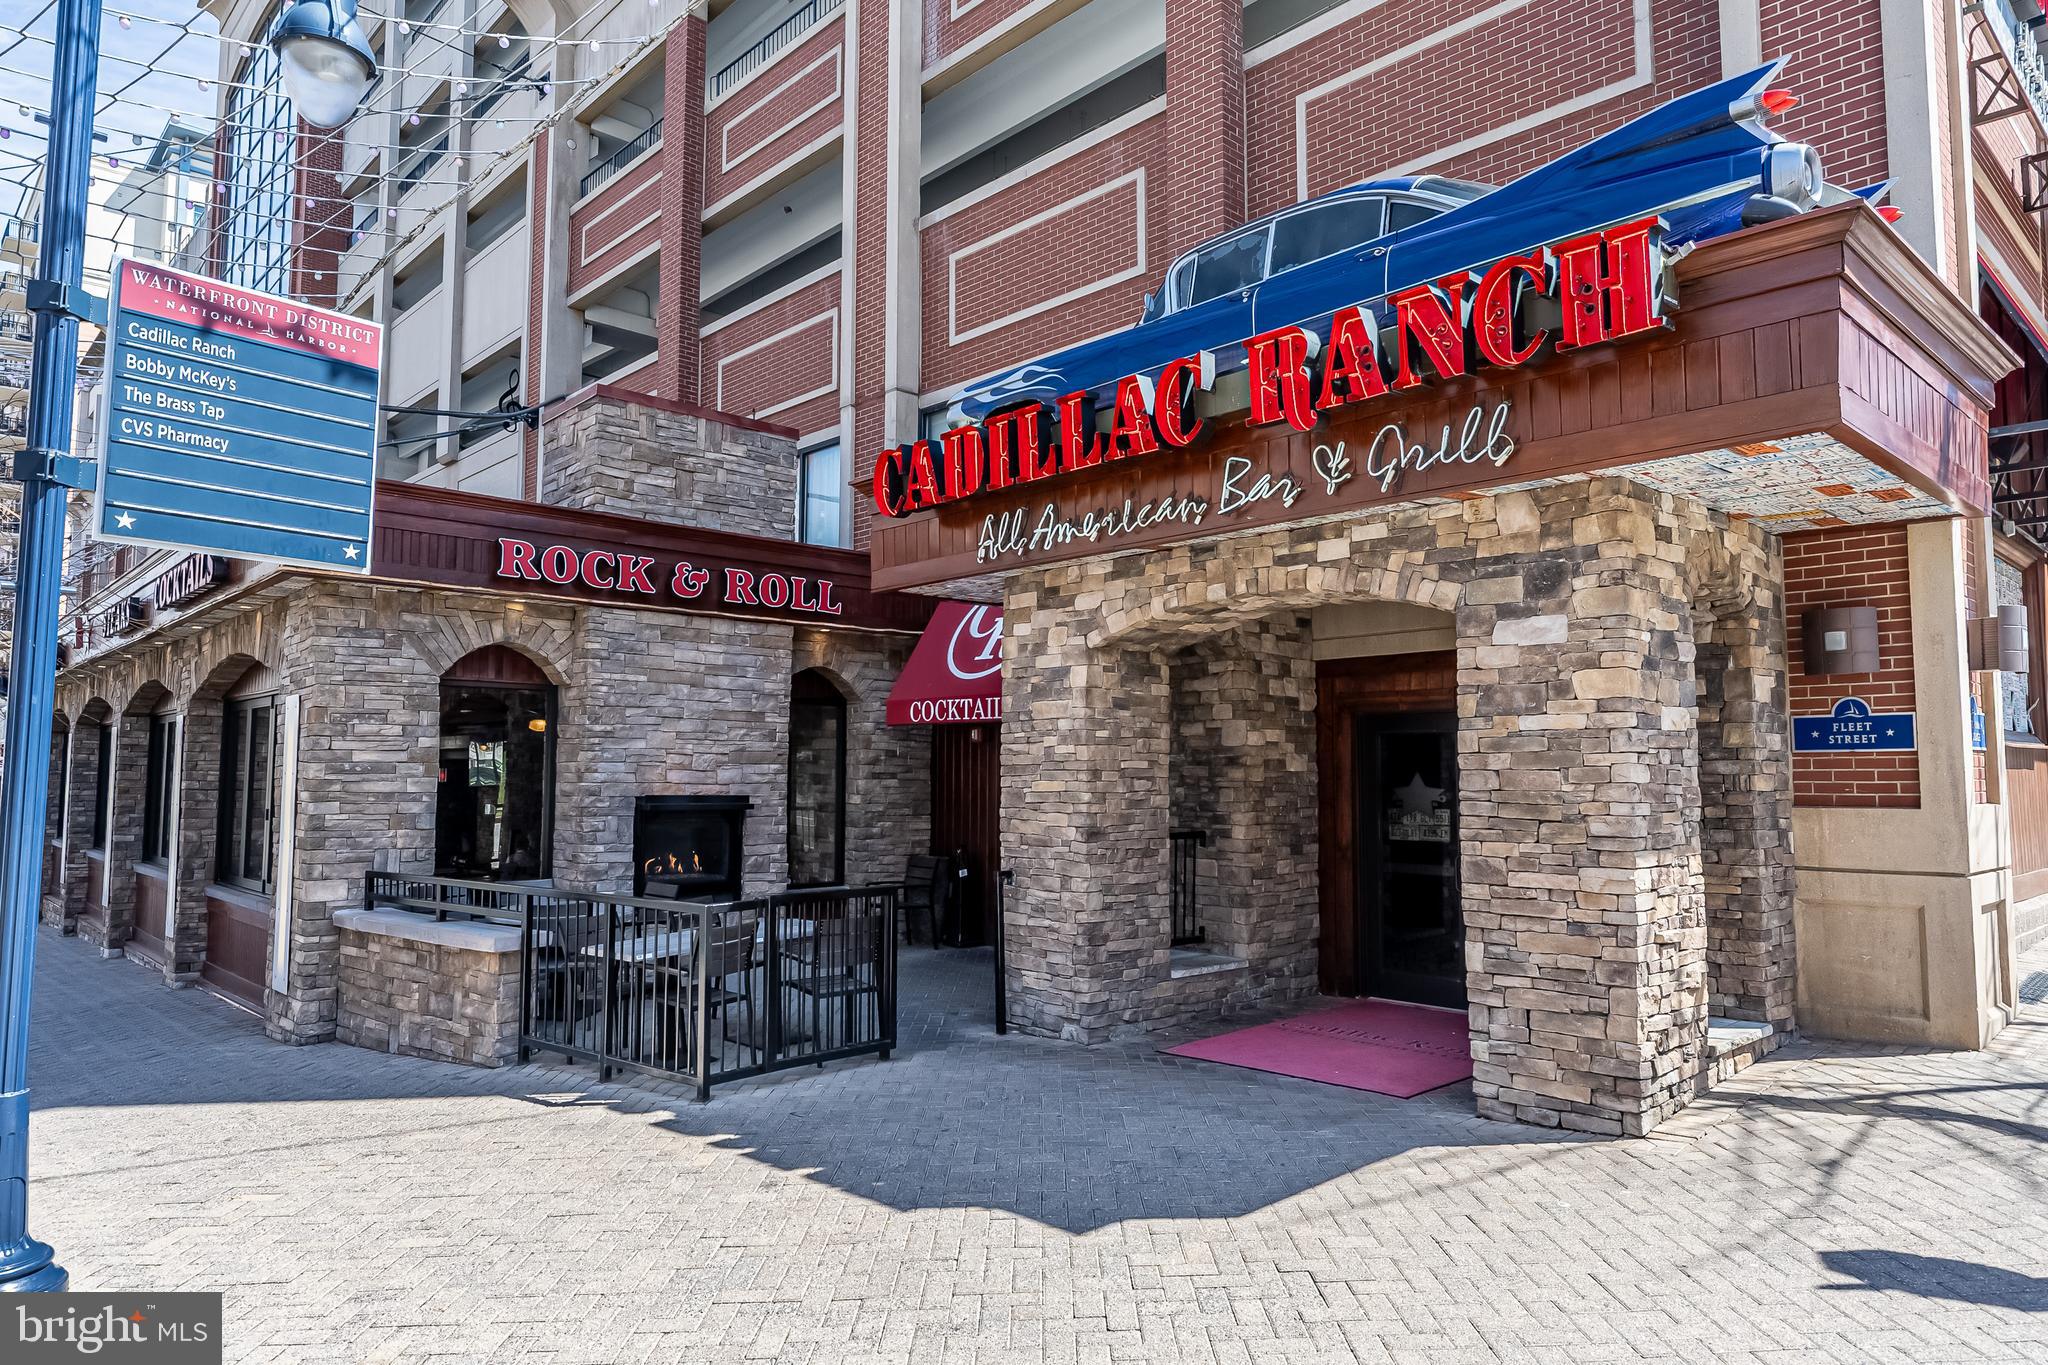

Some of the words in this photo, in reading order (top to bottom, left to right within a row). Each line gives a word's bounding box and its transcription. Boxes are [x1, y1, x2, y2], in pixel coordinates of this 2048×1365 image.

[130, 268, 279, 320] WATERFRONT
[285, 309, 374, 345] DISTRICT
[166, 300, 254, 329] NATIONAL
[286, 330, 347, 353] HARBOR
[127, 322, 188, 349] Cadillac
[192, 338, 236, 361] Ranch
[126, 353, 175, 380] Bobby
[179, 365, 237, 391] McKey's
[872, 350, 1215, 518] CADILLAC
[1242, 215, 1676, 431] RANCH
[123, 385, 152, 405] The
[156, 394, 196, 414] Brass
[199, 400, 225, 420] Tap
[121, 417, 153, 437] CVS
[157, 425, 229, 453] Pharmacy
[976, 506, 1028, 564] All
[1029, 499, 1207, 552] American
[1217, 456, 1303, 515] Bar
[1366, 402, 1515, 493] Grill
[153, 553, 214, 610] COCKTAILS
[497, 537, 656, 594] ROCK
[671, 561, 710, 598] &
[724, 568, 842, 615] ROLL
[1828, 734, 1878, 744] STREET
[1832, 721, 1873, 732] FLEET
